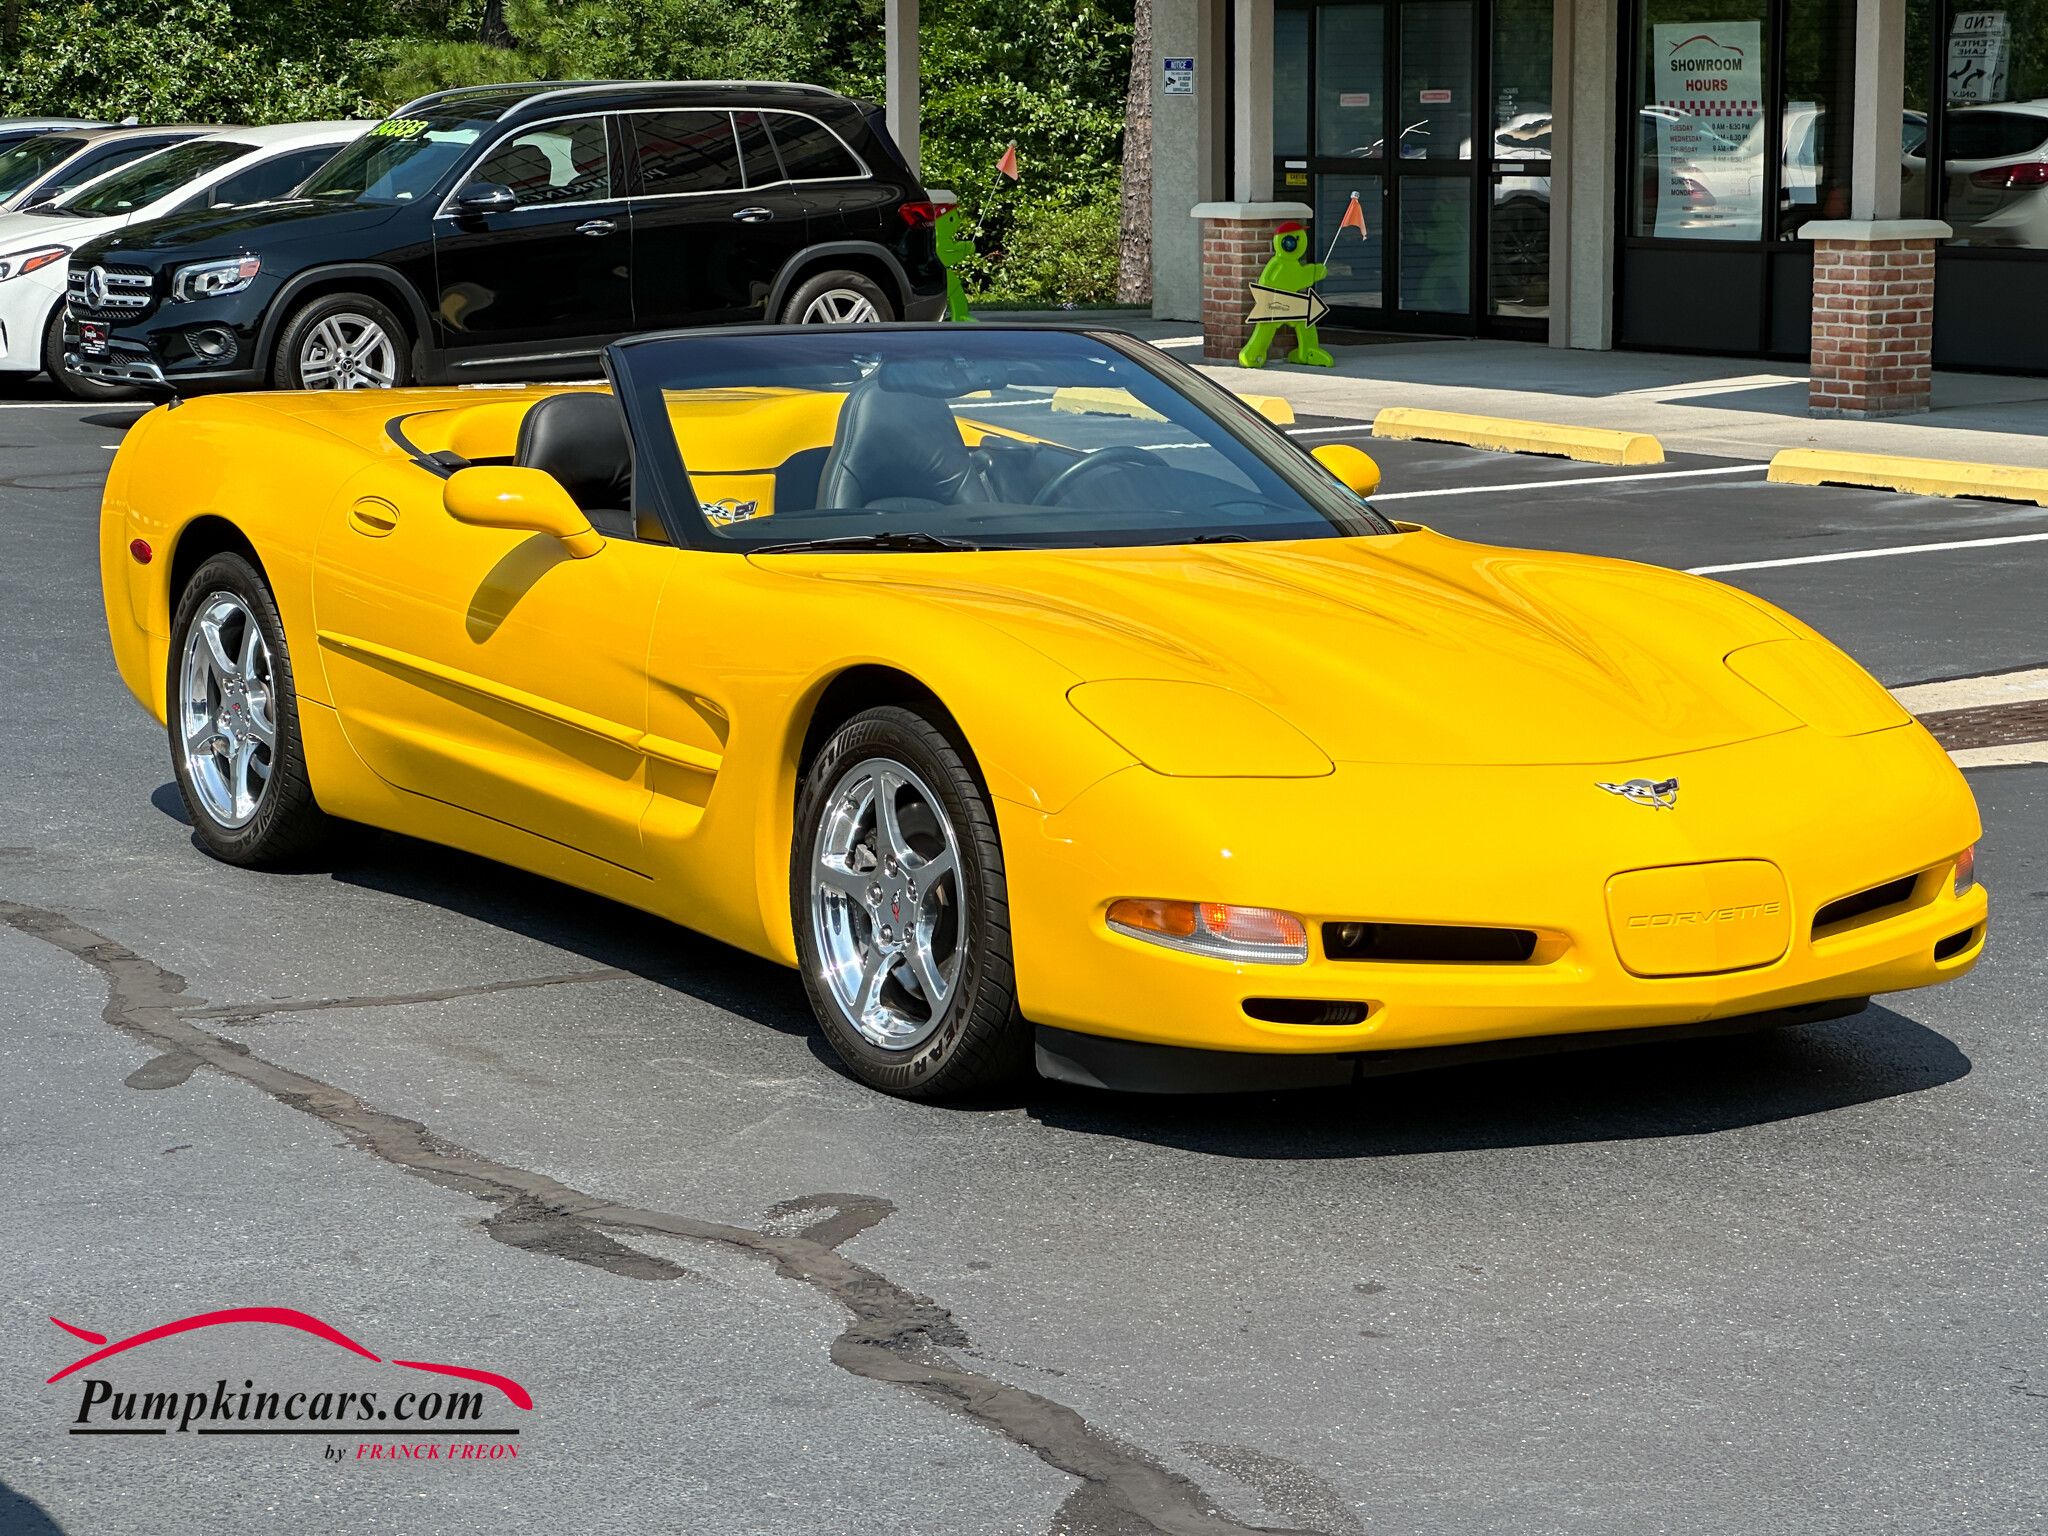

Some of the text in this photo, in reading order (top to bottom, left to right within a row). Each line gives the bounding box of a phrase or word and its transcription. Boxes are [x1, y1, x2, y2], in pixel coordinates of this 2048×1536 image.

[1670, 59, 1742, 72] SHOWROOM
[1685, 79, 1728, 92] HOURS
[1670, 134, 1702, 142] WEDNESDAY
[1670, 145, 1698, 153] THURSDAY
[1627, 901, 1780, 928] CORVETTE
